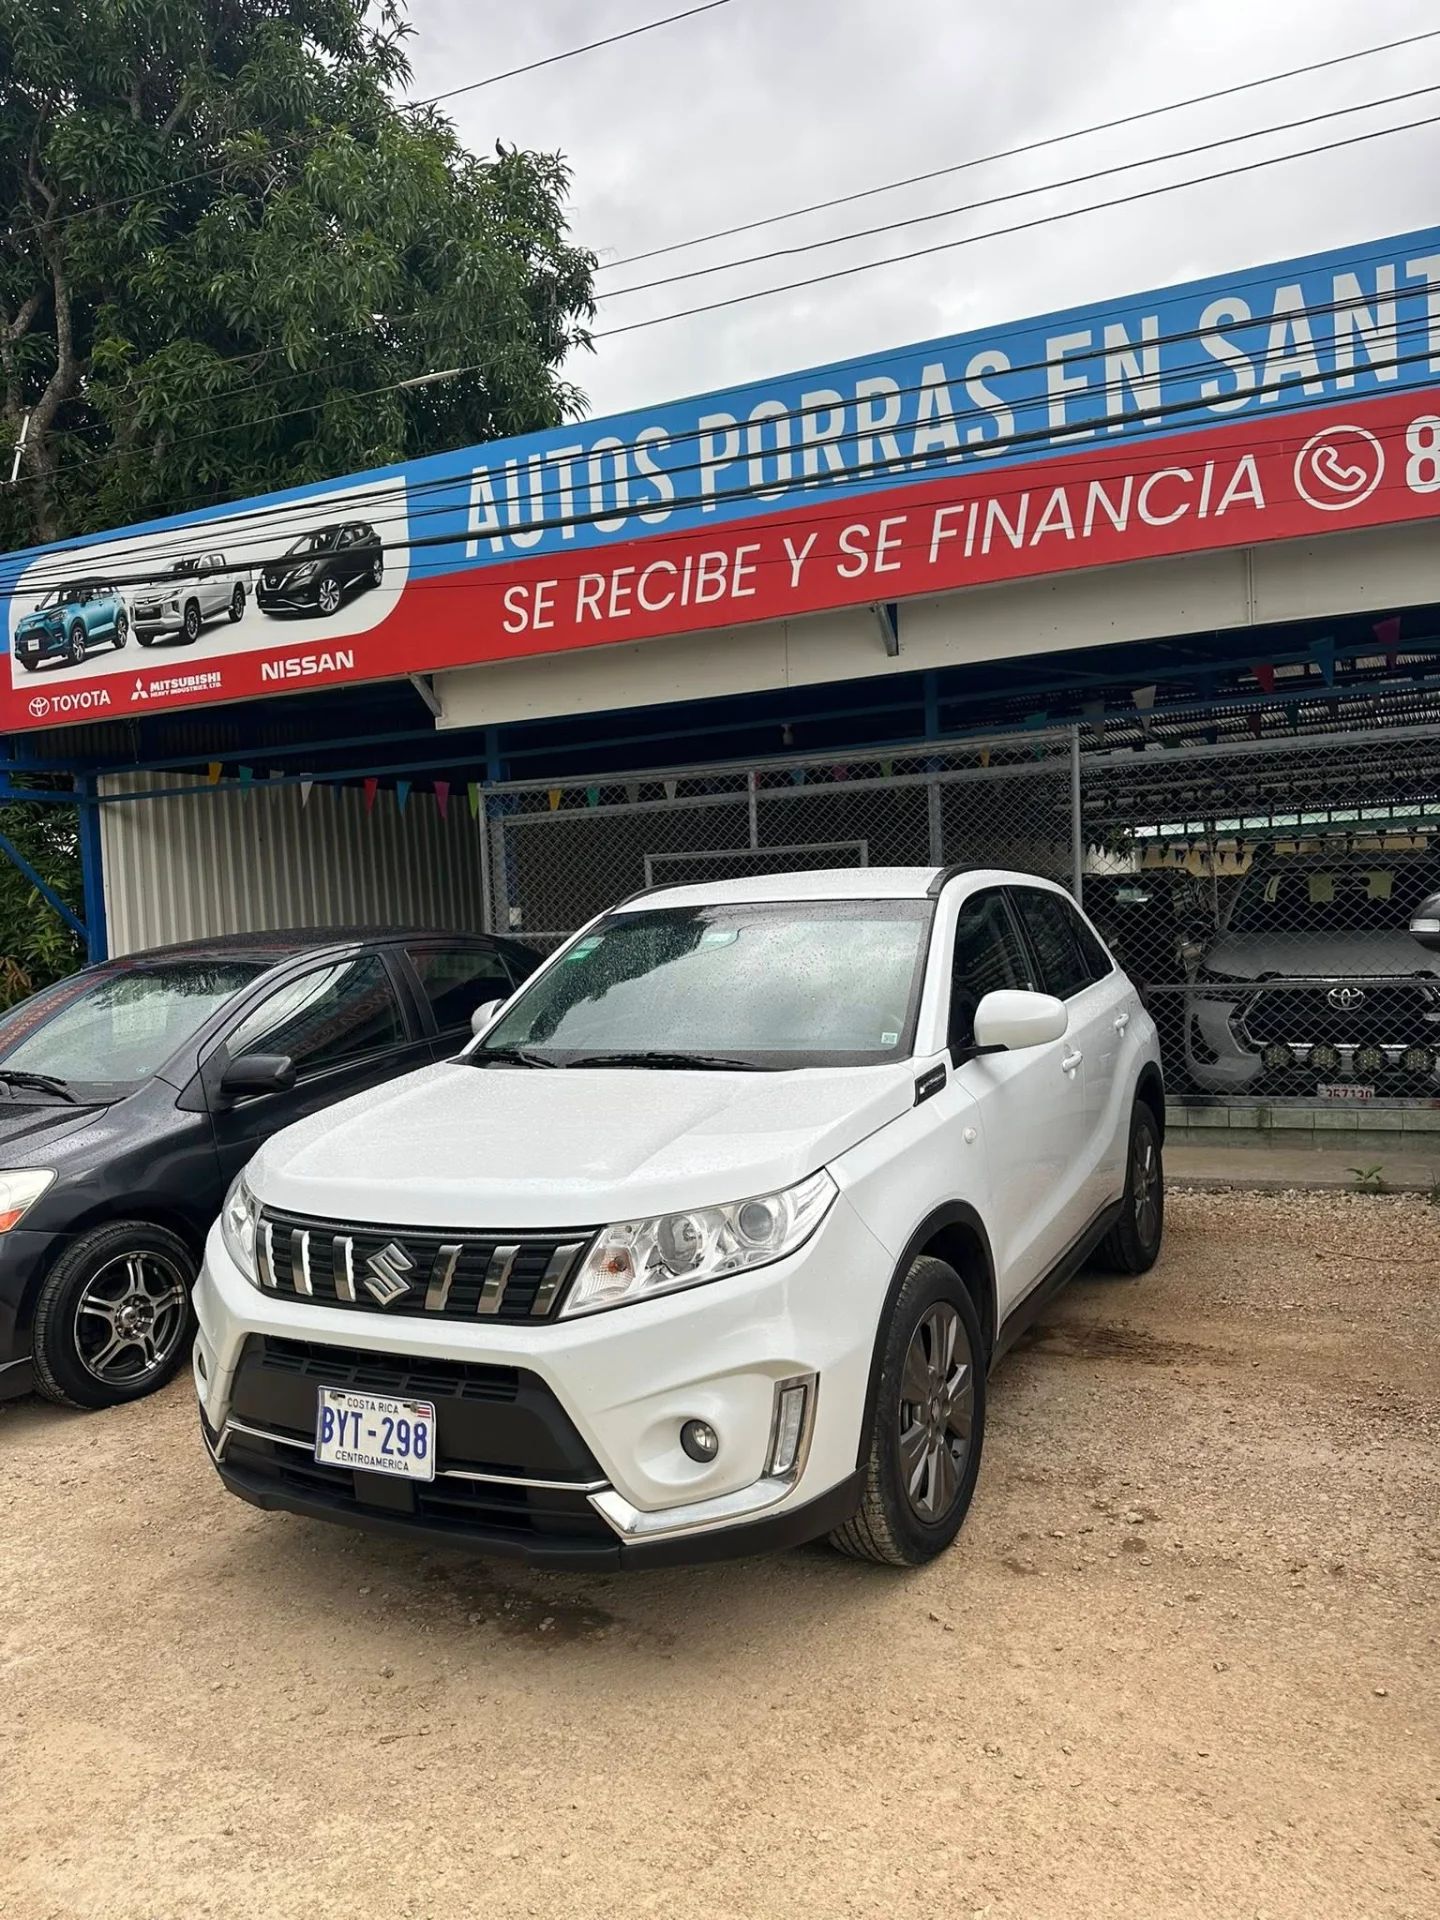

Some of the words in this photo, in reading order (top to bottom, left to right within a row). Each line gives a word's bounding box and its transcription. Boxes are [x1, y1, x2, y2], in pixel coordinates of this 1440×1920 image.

[465, 426, 675, 559] AUTOS
[698, 348, 1016, 512] PORRAS
[1046, 315, 1162, 444] EN
[502, 580, 559, 634] SE
[576, 543, 762, 623] RECIBE
[783, 532, 818, 588] Y
[836, 515, 908, 578] SE
[928, 453, 1266, 564] FINANCIA
[261, 649, 354, 681] NISSAN
[150, 671, 221, 692] MITSUBISHI
[51, 689, 111, 712] TOYOTA
[347, 1397, 376, 1412] COSTA
[378, 1403, 399, 1415] RICA
[335, 1450, 409, 1471] CENTROAMERICA
